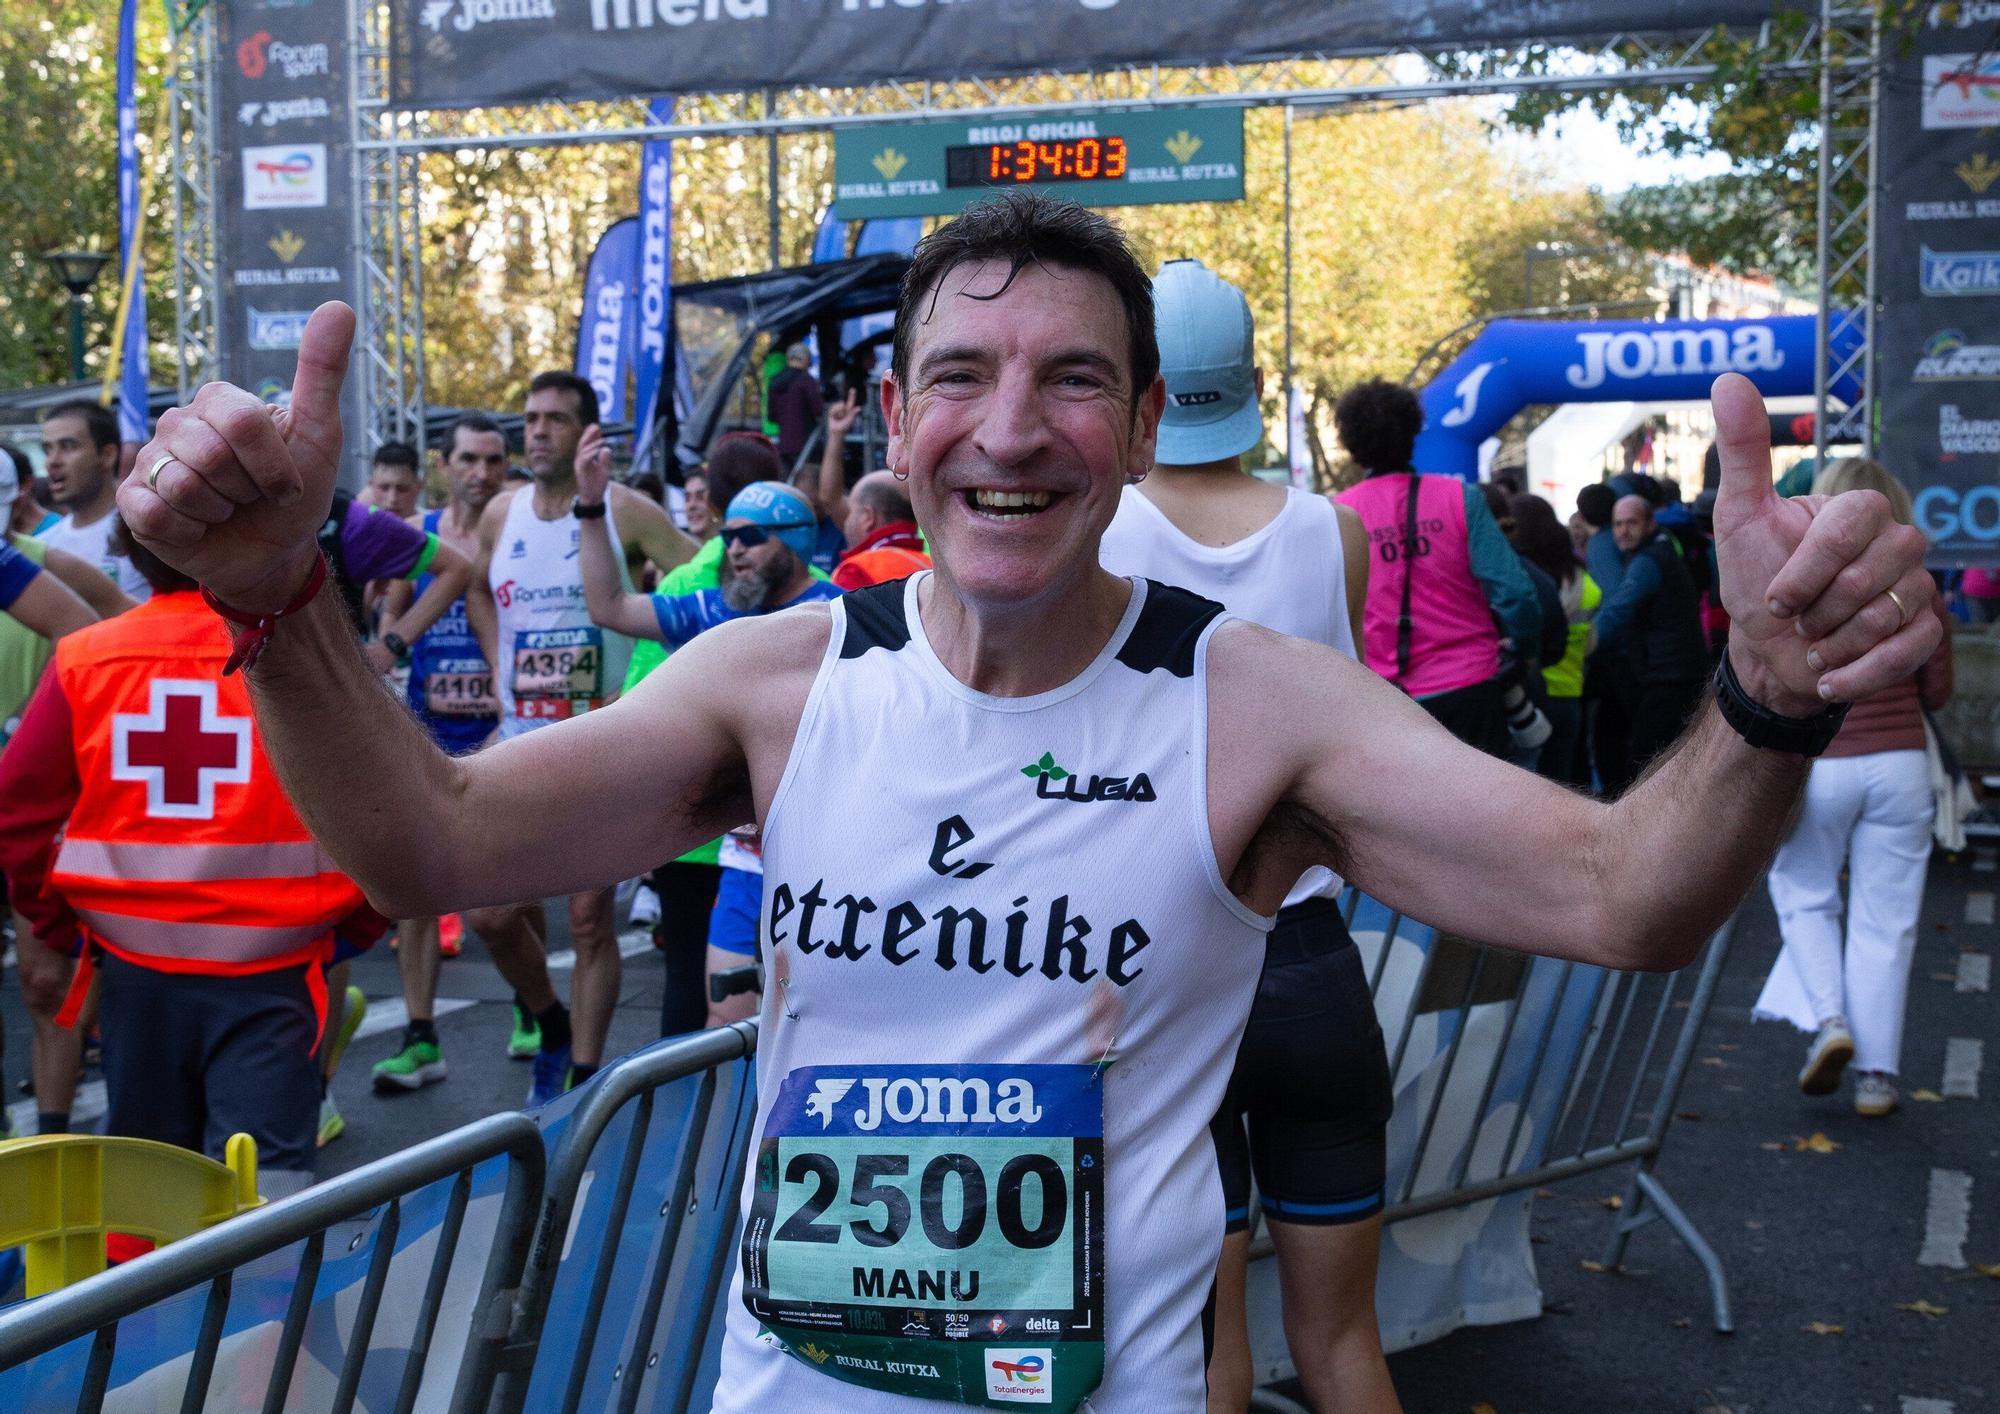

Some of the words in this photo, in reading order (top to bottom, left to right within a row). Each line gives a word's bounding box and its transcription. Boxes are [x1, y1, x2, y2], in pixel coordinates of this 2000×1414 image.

[967, 125, 1024, 144] RELOJ
[1027, 120, 1098, 140] OFICIAL
[990, 136, 1127, 180] 1:34:03
[1129, 166, 1179, 183] RURAL
[1182, 163, 1238, 180] KUTXA
[838, 183, 886, 199] RURAL
[888, 180, 940, 196] KUTXA
[642, 157, 668, 364] Joma
[589, 280, 626, 420] oma
[1566, 325, 1785, 389] Joma
[520, 651, 595, 677] 4384
[1036, 771, 1157, 802] LUGA
[770, 878, 1151, 987] etxenike
[853, 1076, 1043, 1131] Joma
[773, 1152, 1068, 1250] 2500
[852, 1266, 980, 1301] MANU
[945, 1313, 969, 1323] 50/50
[1025, 1317, 1060, 1330] delta
[835, 1355, 884, 1371] RURAL
[885, 1361, 941, 1378] KUTXA
[993, 1385, 1045, 1396] TotalEnergies
